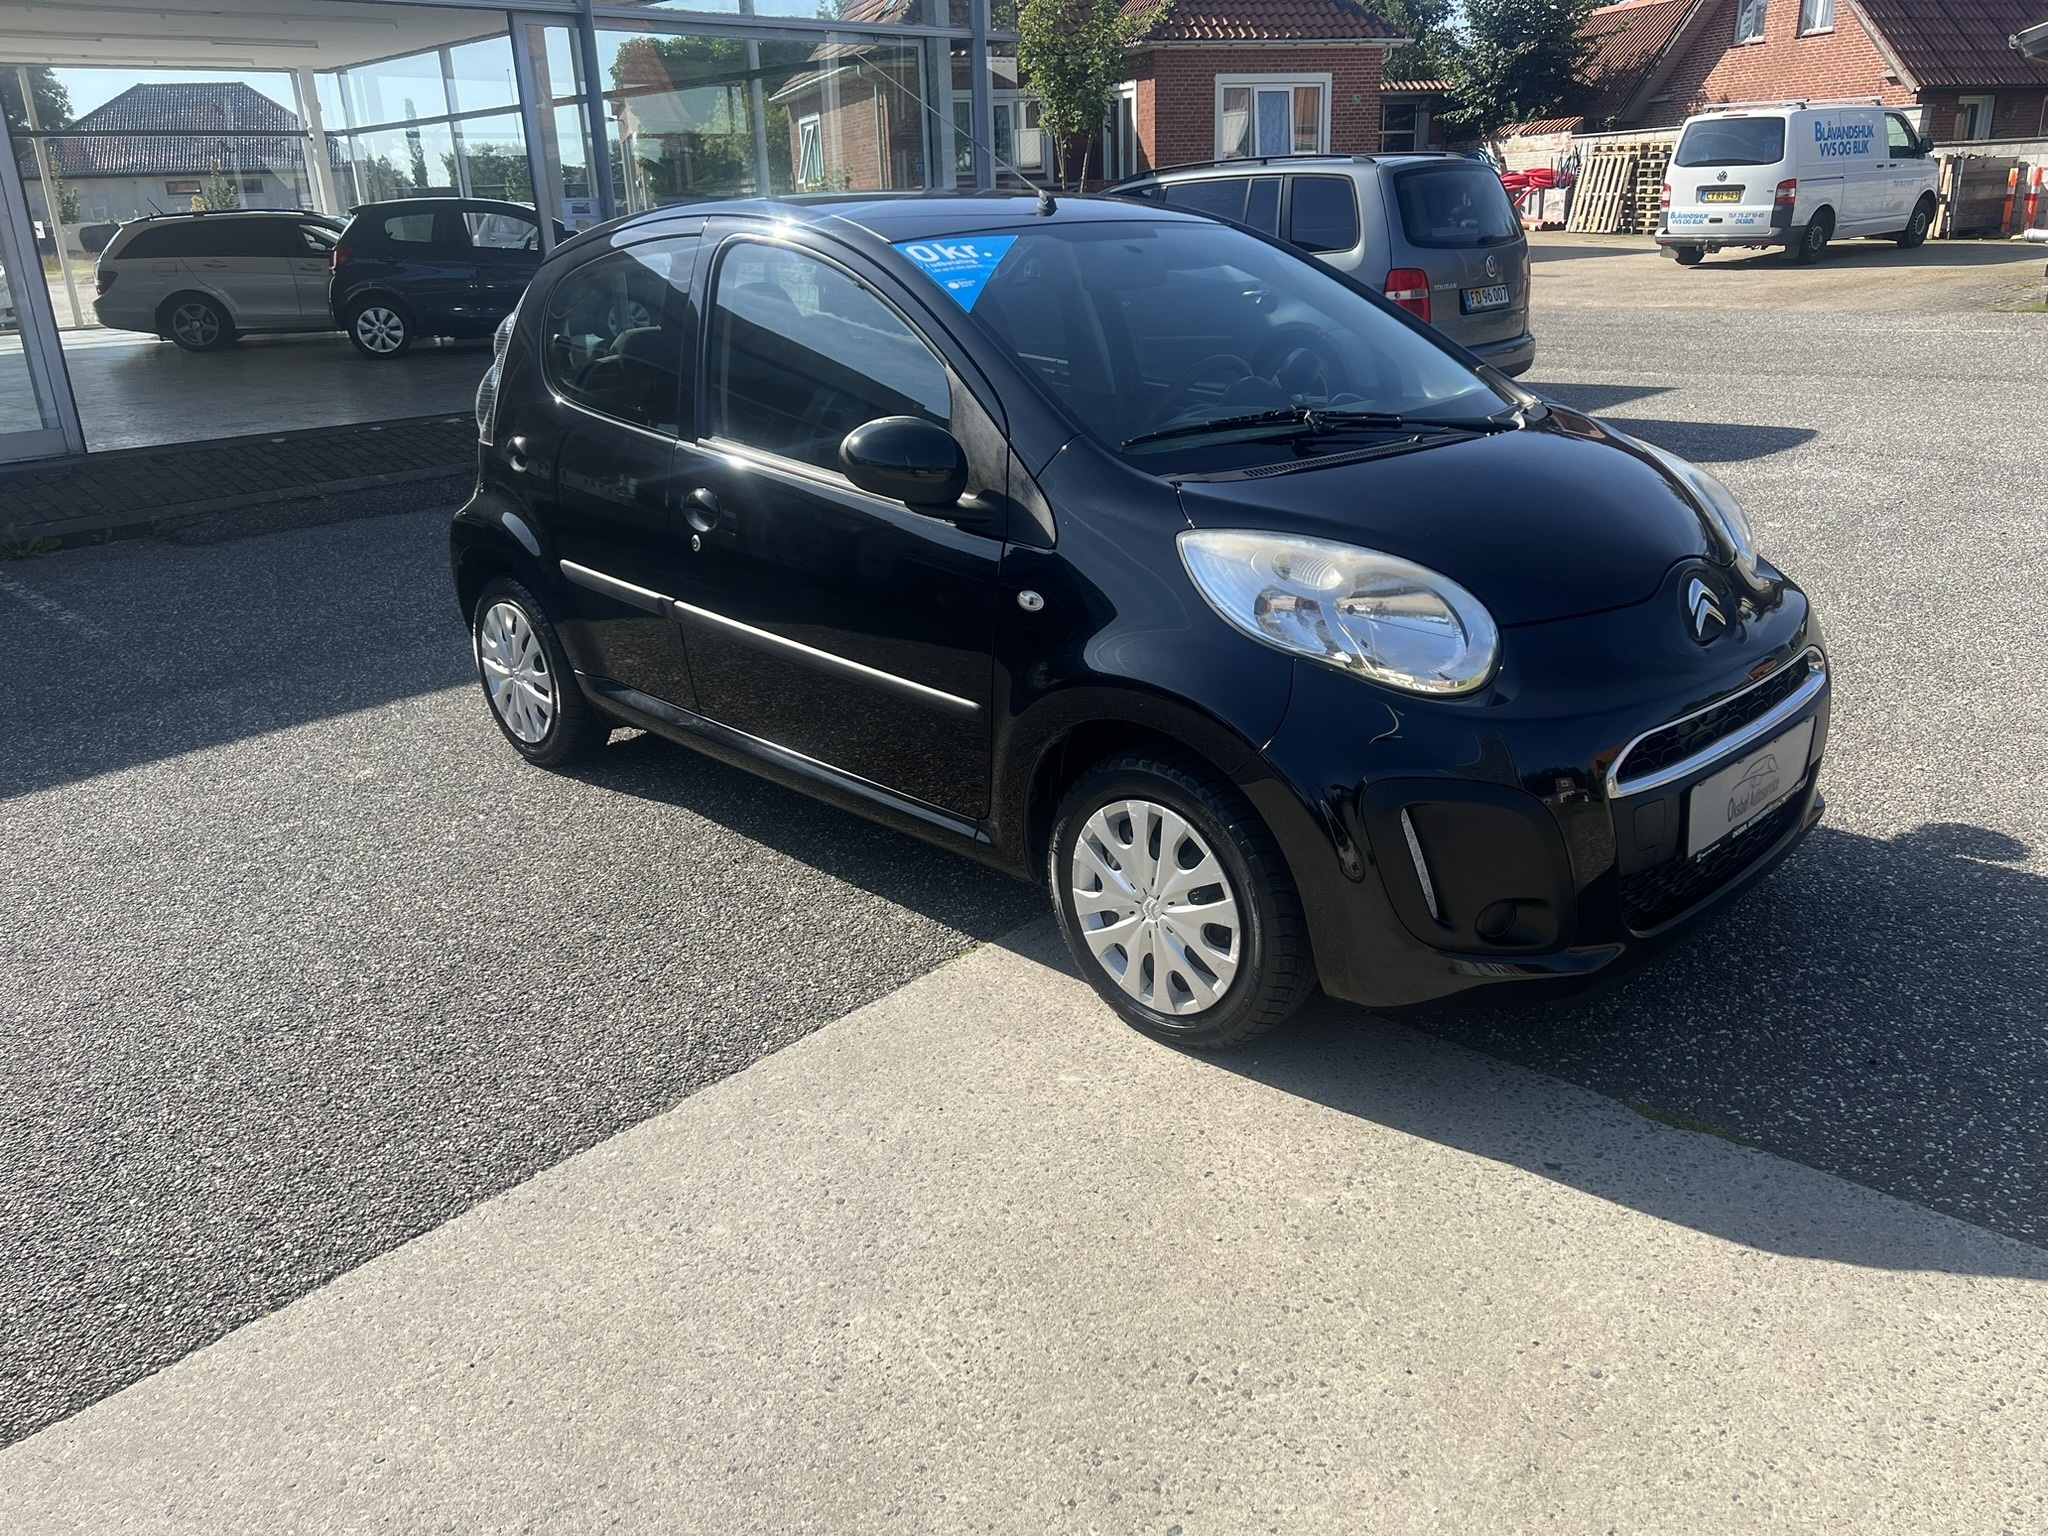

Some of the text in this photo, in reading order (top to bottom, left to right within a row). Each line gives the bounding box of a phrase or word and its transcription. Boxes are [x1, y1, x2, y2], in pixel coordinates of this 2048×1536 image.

[1815, 120, 1874, 141] BLÅVANDSHUK
[1820, 139, 1869, 157] VVS OG BLIK
[1433, 282, 1457, 291] TOURAN
[1470, 287, 1507, 305] FD 96 007
